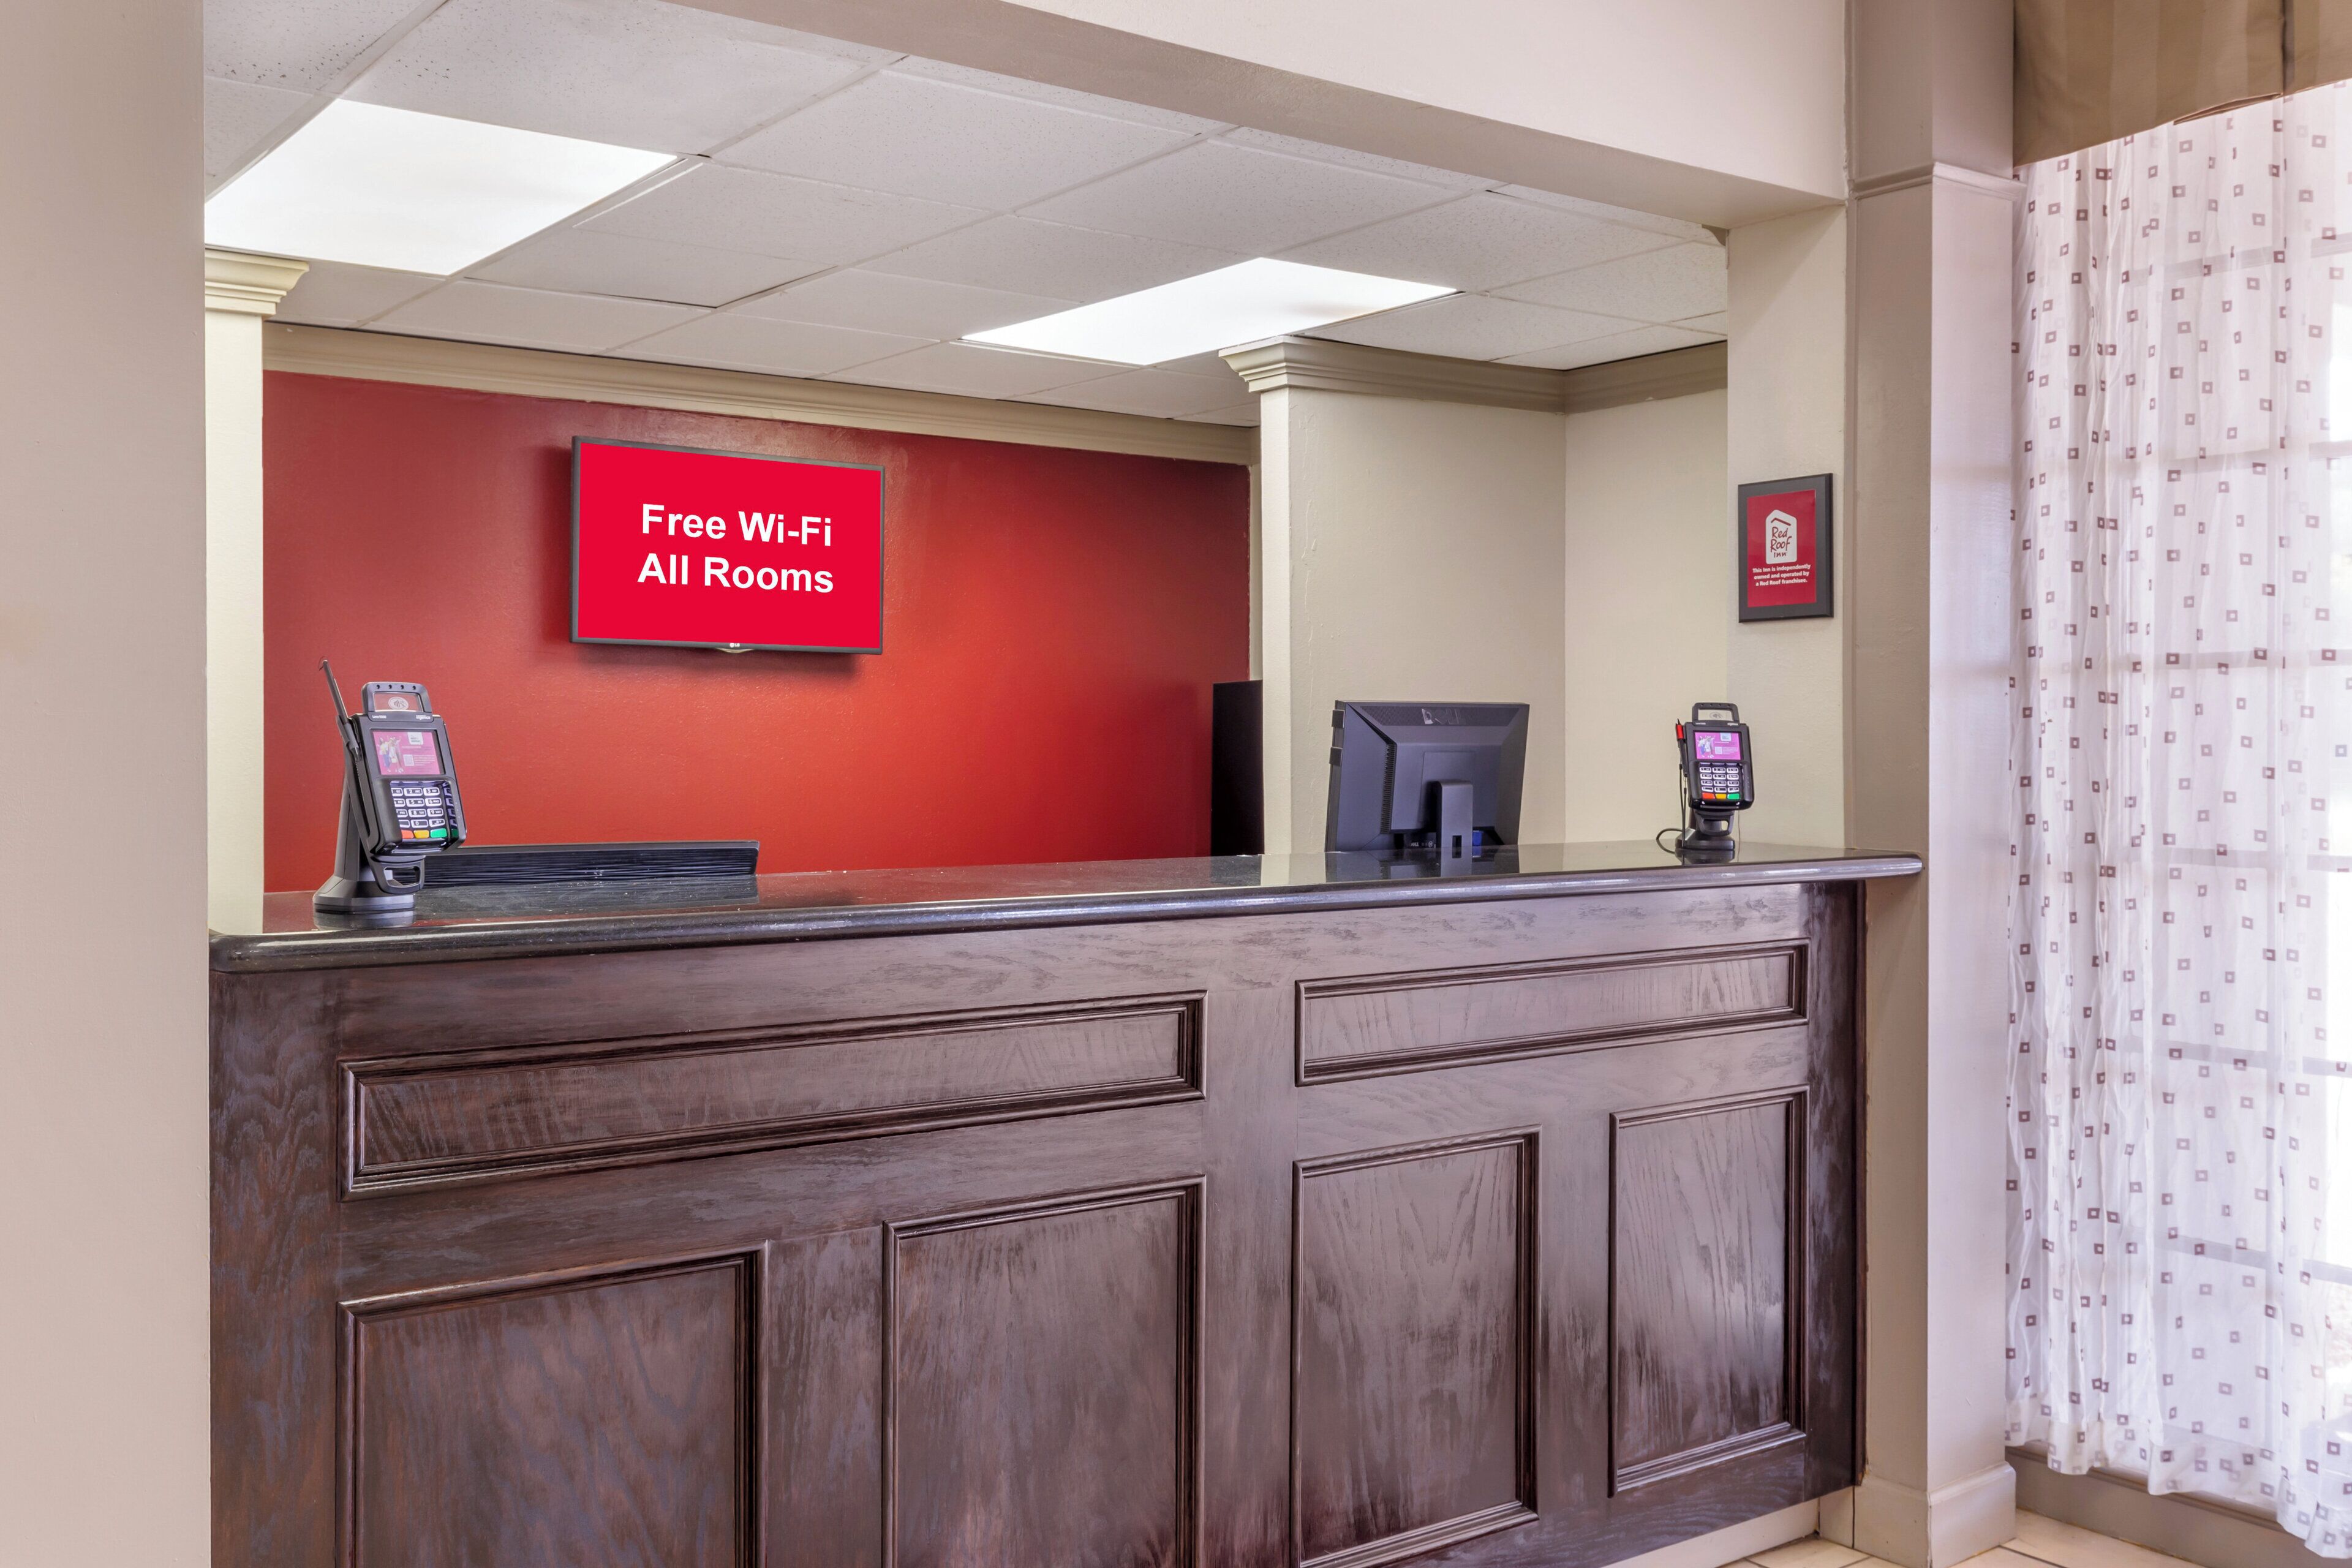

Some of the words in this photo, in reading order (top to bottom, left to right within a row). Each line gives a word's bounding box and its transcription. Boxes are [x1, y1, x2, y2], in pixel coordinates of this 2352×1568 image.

[643, 503, 726, 540] Free
[738, 511, 832, 546] Wi-Fi
[1771, 526, 1789, 538] Red
[1770, 536, 1792, 552] Roof
[637, 552, 688, 584] All
[704, 556, 834, 594] Rooms
